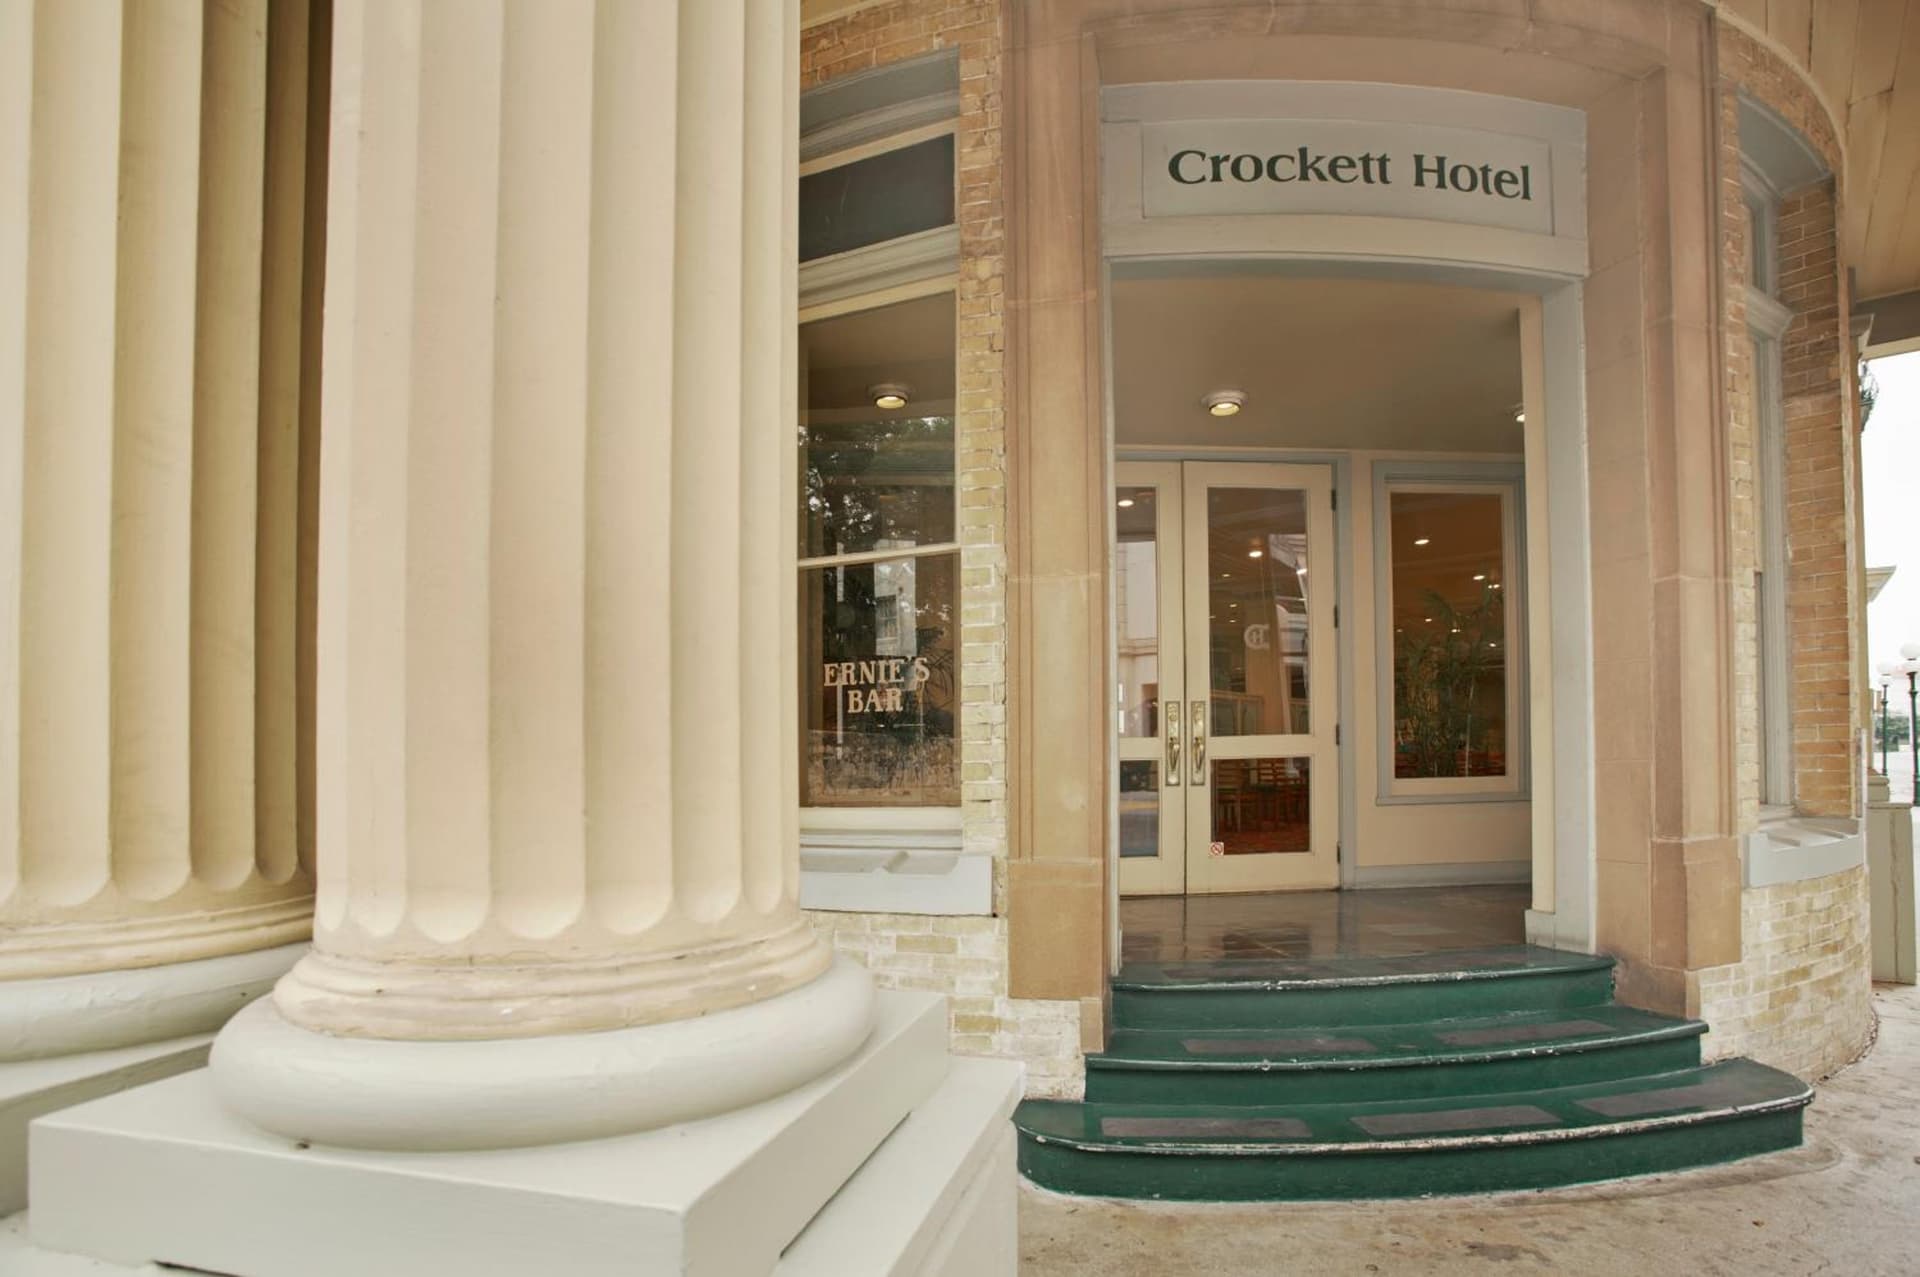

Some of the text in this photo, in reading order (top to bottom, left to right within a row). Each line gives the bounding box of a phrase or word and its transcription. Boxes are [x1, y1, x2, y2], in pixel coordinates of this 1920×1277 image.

[1168, 146, 1532, 201] Crockett Hotel
[823, 657, 931, 687] ERNIE'S
[847, 687, 904, 714] BAR
